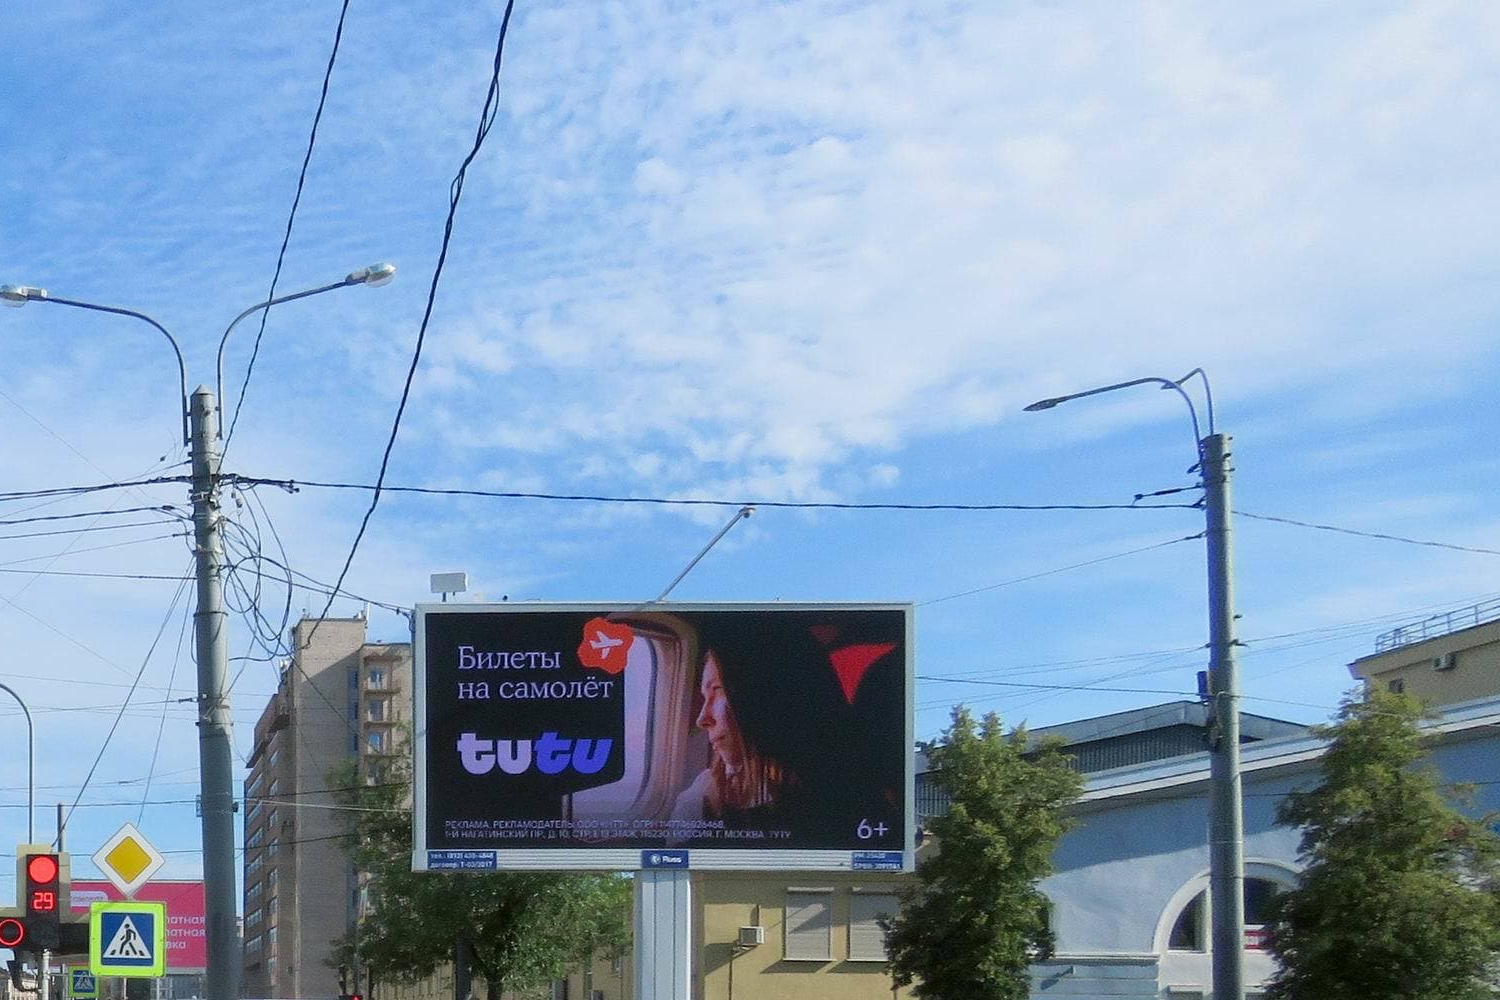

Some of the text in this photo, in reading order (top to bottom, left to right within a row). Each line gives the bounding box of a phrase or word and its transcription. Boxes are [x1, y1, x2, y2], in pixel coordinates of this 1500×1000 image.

[457, 645, 561, 670] Билеты
[457, 676, 614, 700] на самолёт
[456, 731, 613, 775] tutu
[857, 818, 889, 839] 6+
[662, 855, 682, 863] Russ
[33, 892, 53, 910] 29
